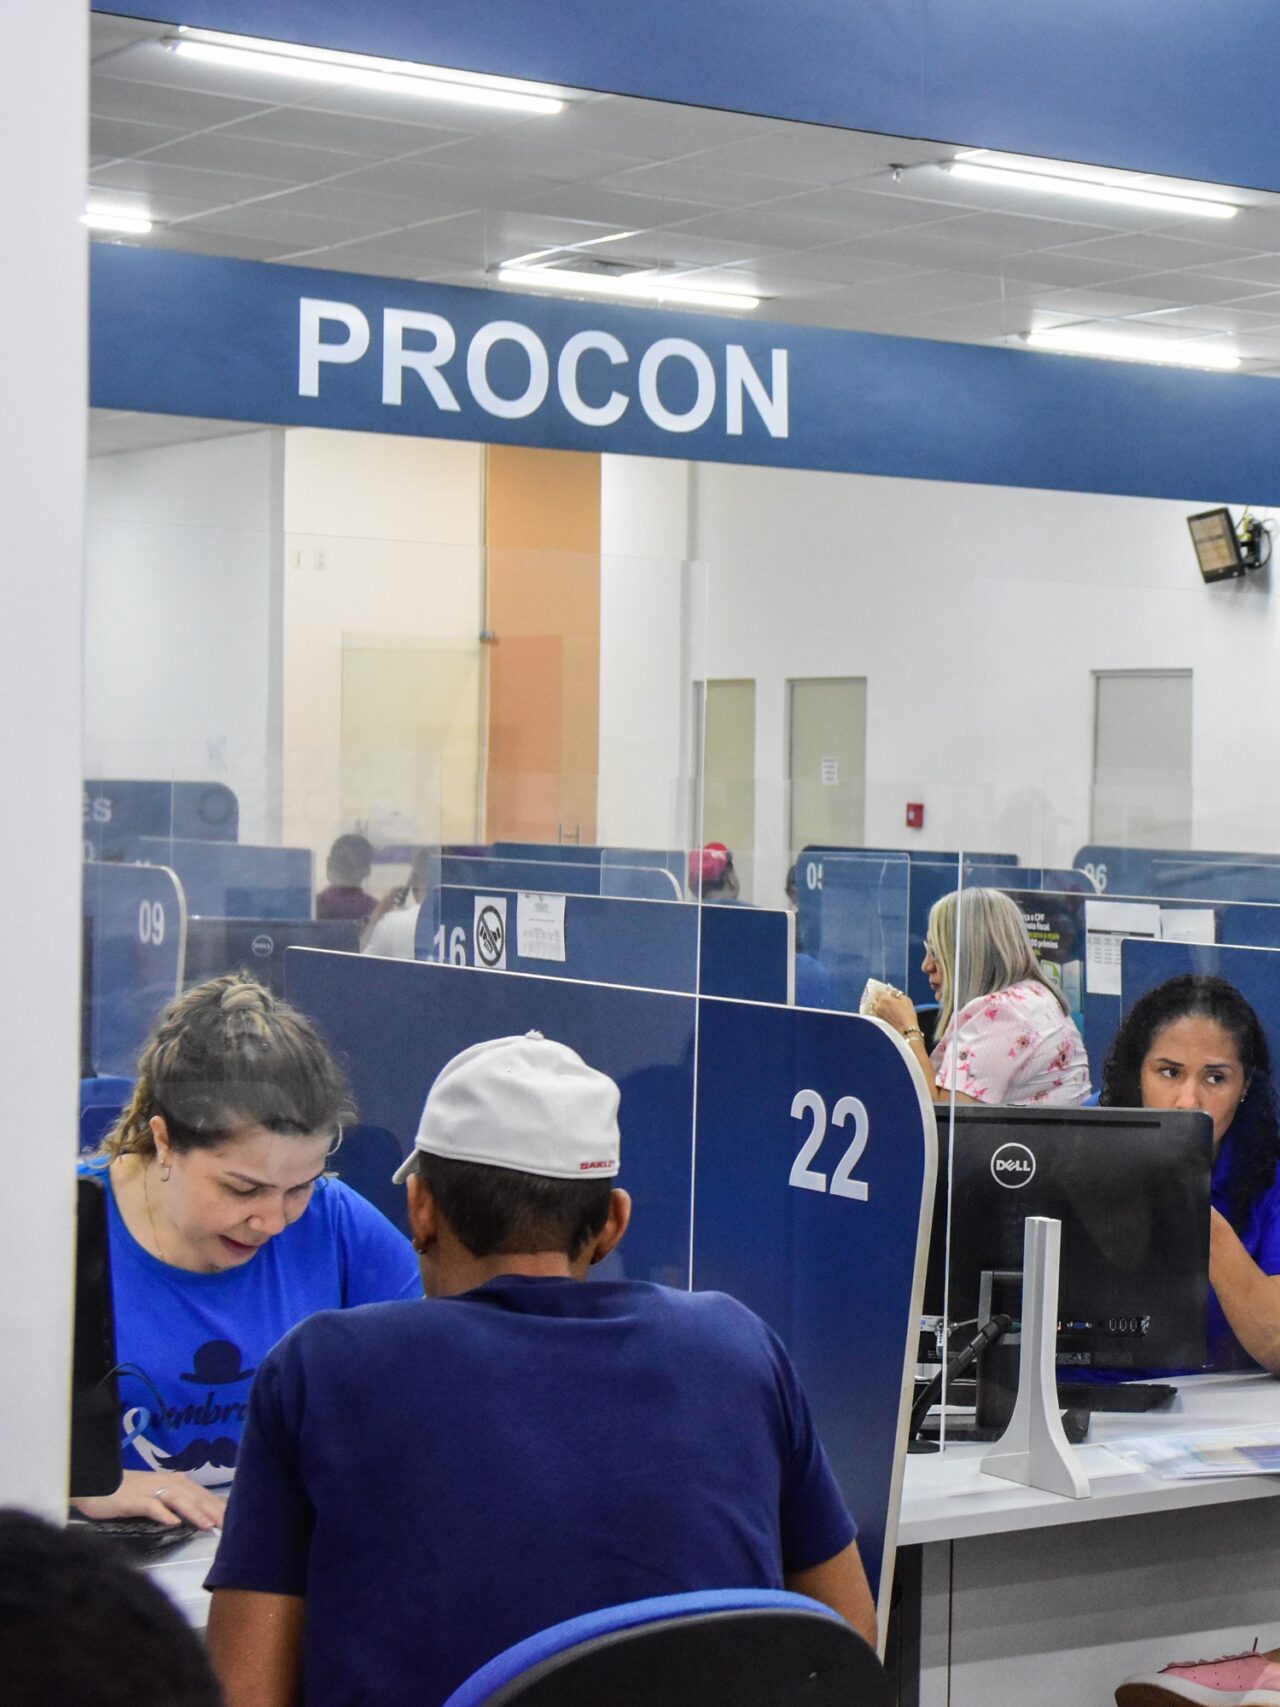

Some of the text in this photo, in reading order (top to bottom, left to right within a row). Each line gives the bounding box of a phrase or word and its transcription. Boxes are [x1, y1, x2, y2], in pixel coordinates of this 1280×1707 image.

[298, 297, 788, 438] PROCON
[139, 900, 165, 946] 09
[433, 925, 467, 966] 16
[789, 1089, 869, 1202] 22
[996, 1159, 1030, 1171] DELL
